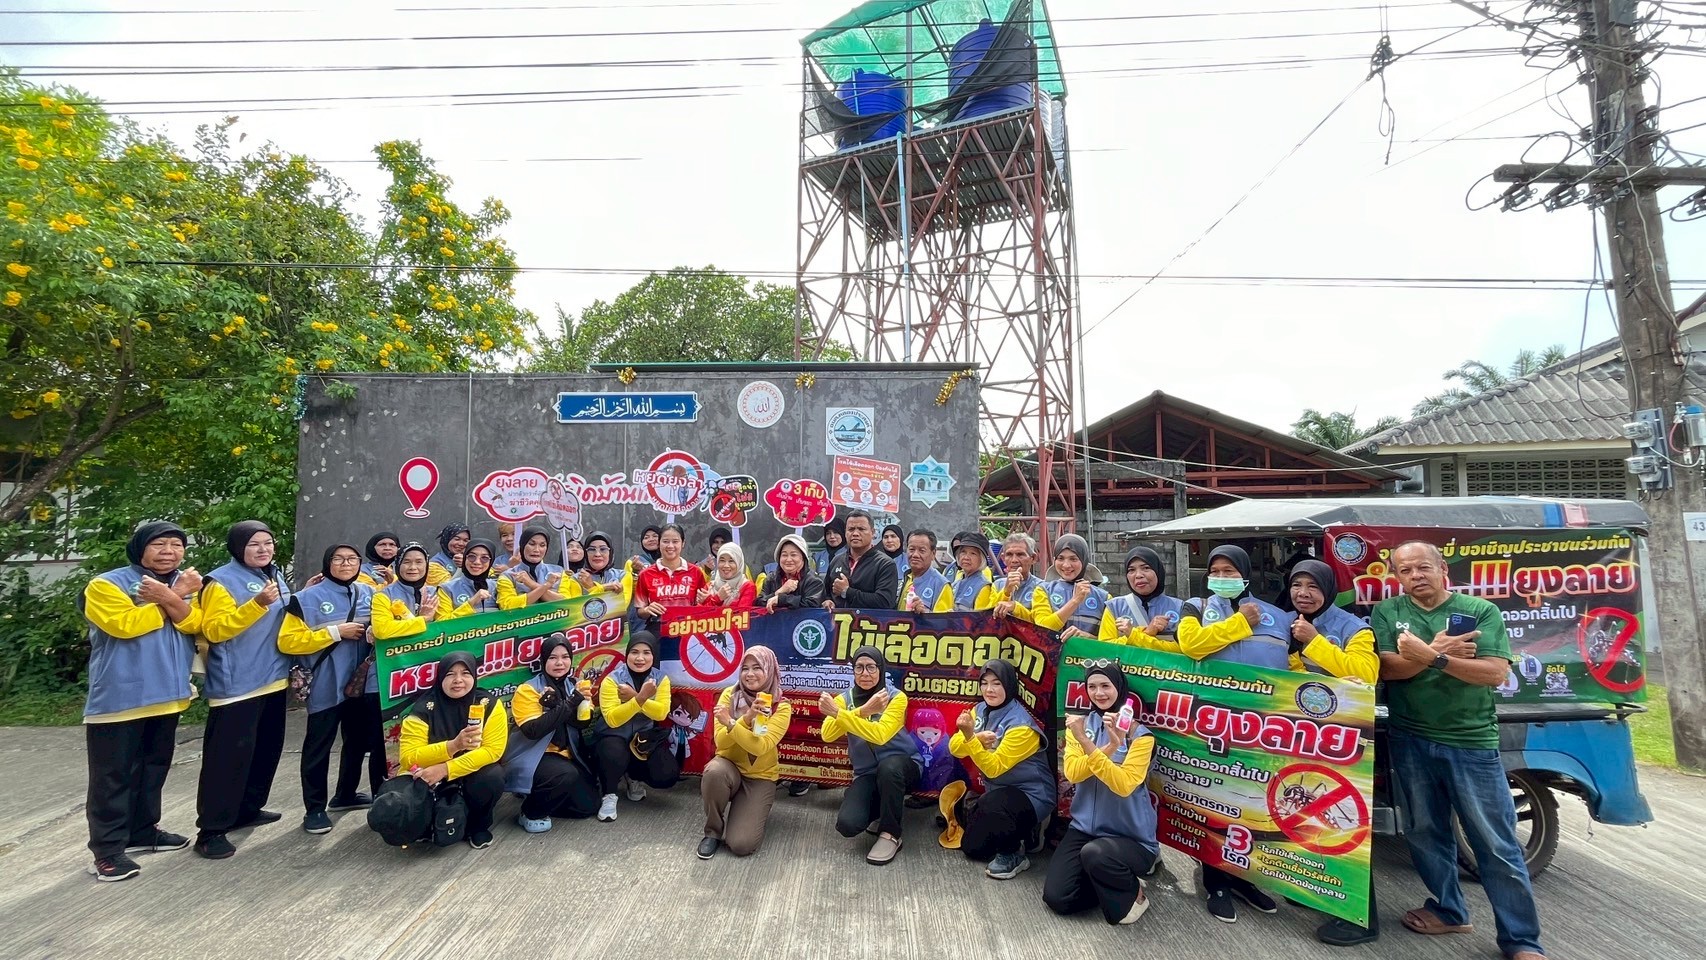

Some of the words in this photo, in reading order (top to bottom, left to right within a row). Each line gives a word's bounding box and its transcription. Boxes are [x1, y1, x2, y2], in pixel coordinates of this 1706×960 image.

[496, 478, 538, 492] ยุงลาย
[633, 470, 705, 490] หยุดยุงลา
[793, 483, 802, 495] 3
[804, 482, 825, 500] เก็บ
[1459, 534, 1631, 560] ขอเชิญประชาชนร่วมกัน
[656, 584, 691, 598] KRABI
[1512, 560, 1640, 608] ยุงลาย
[385, 633, 446, 657] อบจ.กระบี่
[447, 608, 570, 644] ขอเชิญประชาชนร่วมกัน
[668, 608, 749, 636] อย่าวางใจ!
[834, 613, 1046, 683] ไข้เลือดออก
[780, 674, 851, 689] งมียุงลายเป็นพาหะ
[1121, 662, 1274, 696] ขอเชิญประชาชนร่วมกัน
[1194, 703, 1362, 764] ยุงลาย
[1163, 782, 1241, 818] ด้วยมาตรการ
[1227, 823, 1252, 855] 3
[1221, 846, 1250, 869] โรค
